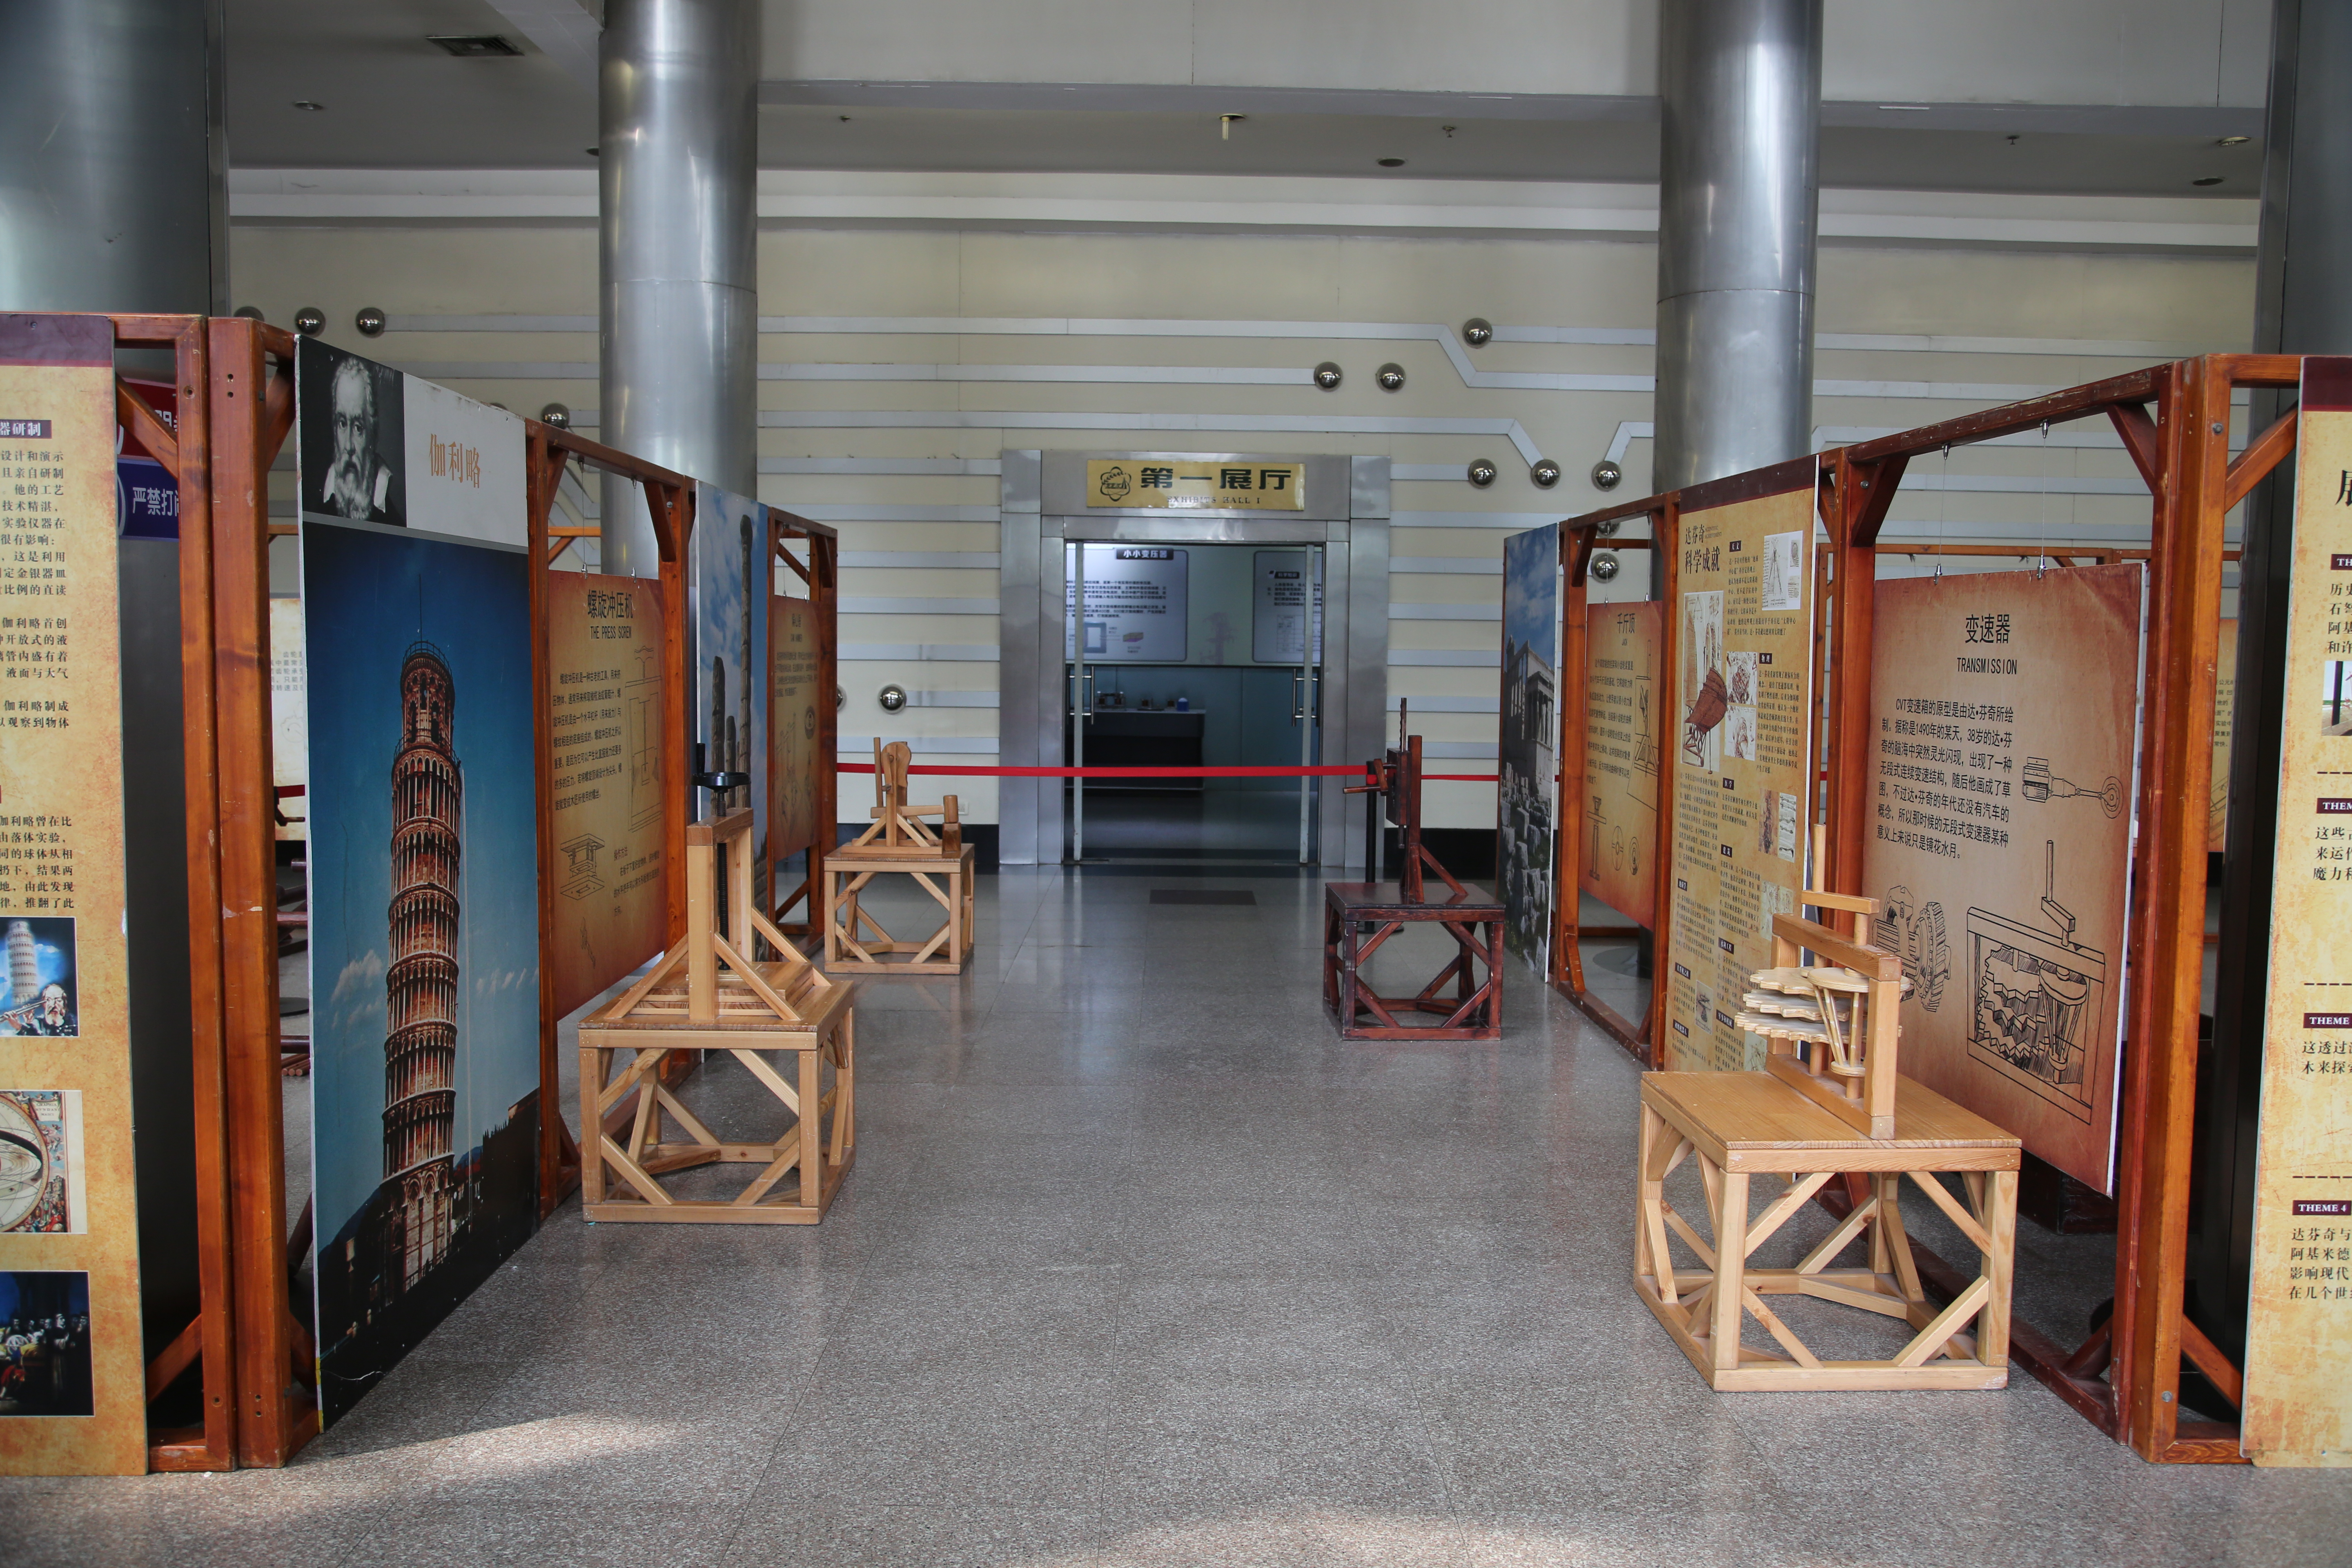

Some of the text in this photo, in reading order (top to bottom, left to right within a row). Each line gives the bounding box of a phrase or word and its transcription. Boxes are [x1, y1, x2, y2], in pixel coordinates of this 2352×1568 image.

[1, 450, 64, 462] 设计和演示
[429, 434, 481, 489] 伽利略
[2, 468, 64, 479] 且亲自研制
[1140, 468, 1291, 490] 第一展厅
[2, 517, 66, 529] 实验仪器在
[1685, 524, 1705, 545] 达芬奇
[1685, 546, 1720, 574] 科学成就
[0, 584, 67, 596] 比例的直读
[588, 590, 633, 619] 螺旋冲压机
[2, 617, 66, 629] 伽利略首创
[1617, 613, 1635, 634] 千斤顶
[1965, 614, 2011, 644] 变速器
[590, 626, 632, 639] THE PRESS SCREW
[1761, 654, 1770, 663] 物理
[7, 667, 69, 679] 液面与大气
[1957, 657, 2017, 675] TRANSMISSION
[4, 700, 69, 712] 伽利略制成
[1881, 739, 2012, 773] 奇的脑海中突然灵光闪现，出现了一种
[1724, 780, 1732, 788] 医学
[1880, 761, 2011, 798] 无段式连续变速结构，随后他画成了草
[1878, 803, 2009, 848] 概念，所以那时候的无段式变速器某种
[1877, 824, 1960, 859] 意义上来说只是镜花水月。
[1723, 846, 1730, 856] 建筑
[1721, 940, 1732, 952] 水利工程
[2292, 1227, 2351, 1241] 达芬奇与
[2291, 1247, 2350, 1261] 阿基米德
[2289, 1285, 2352, 1300] 在几个世
